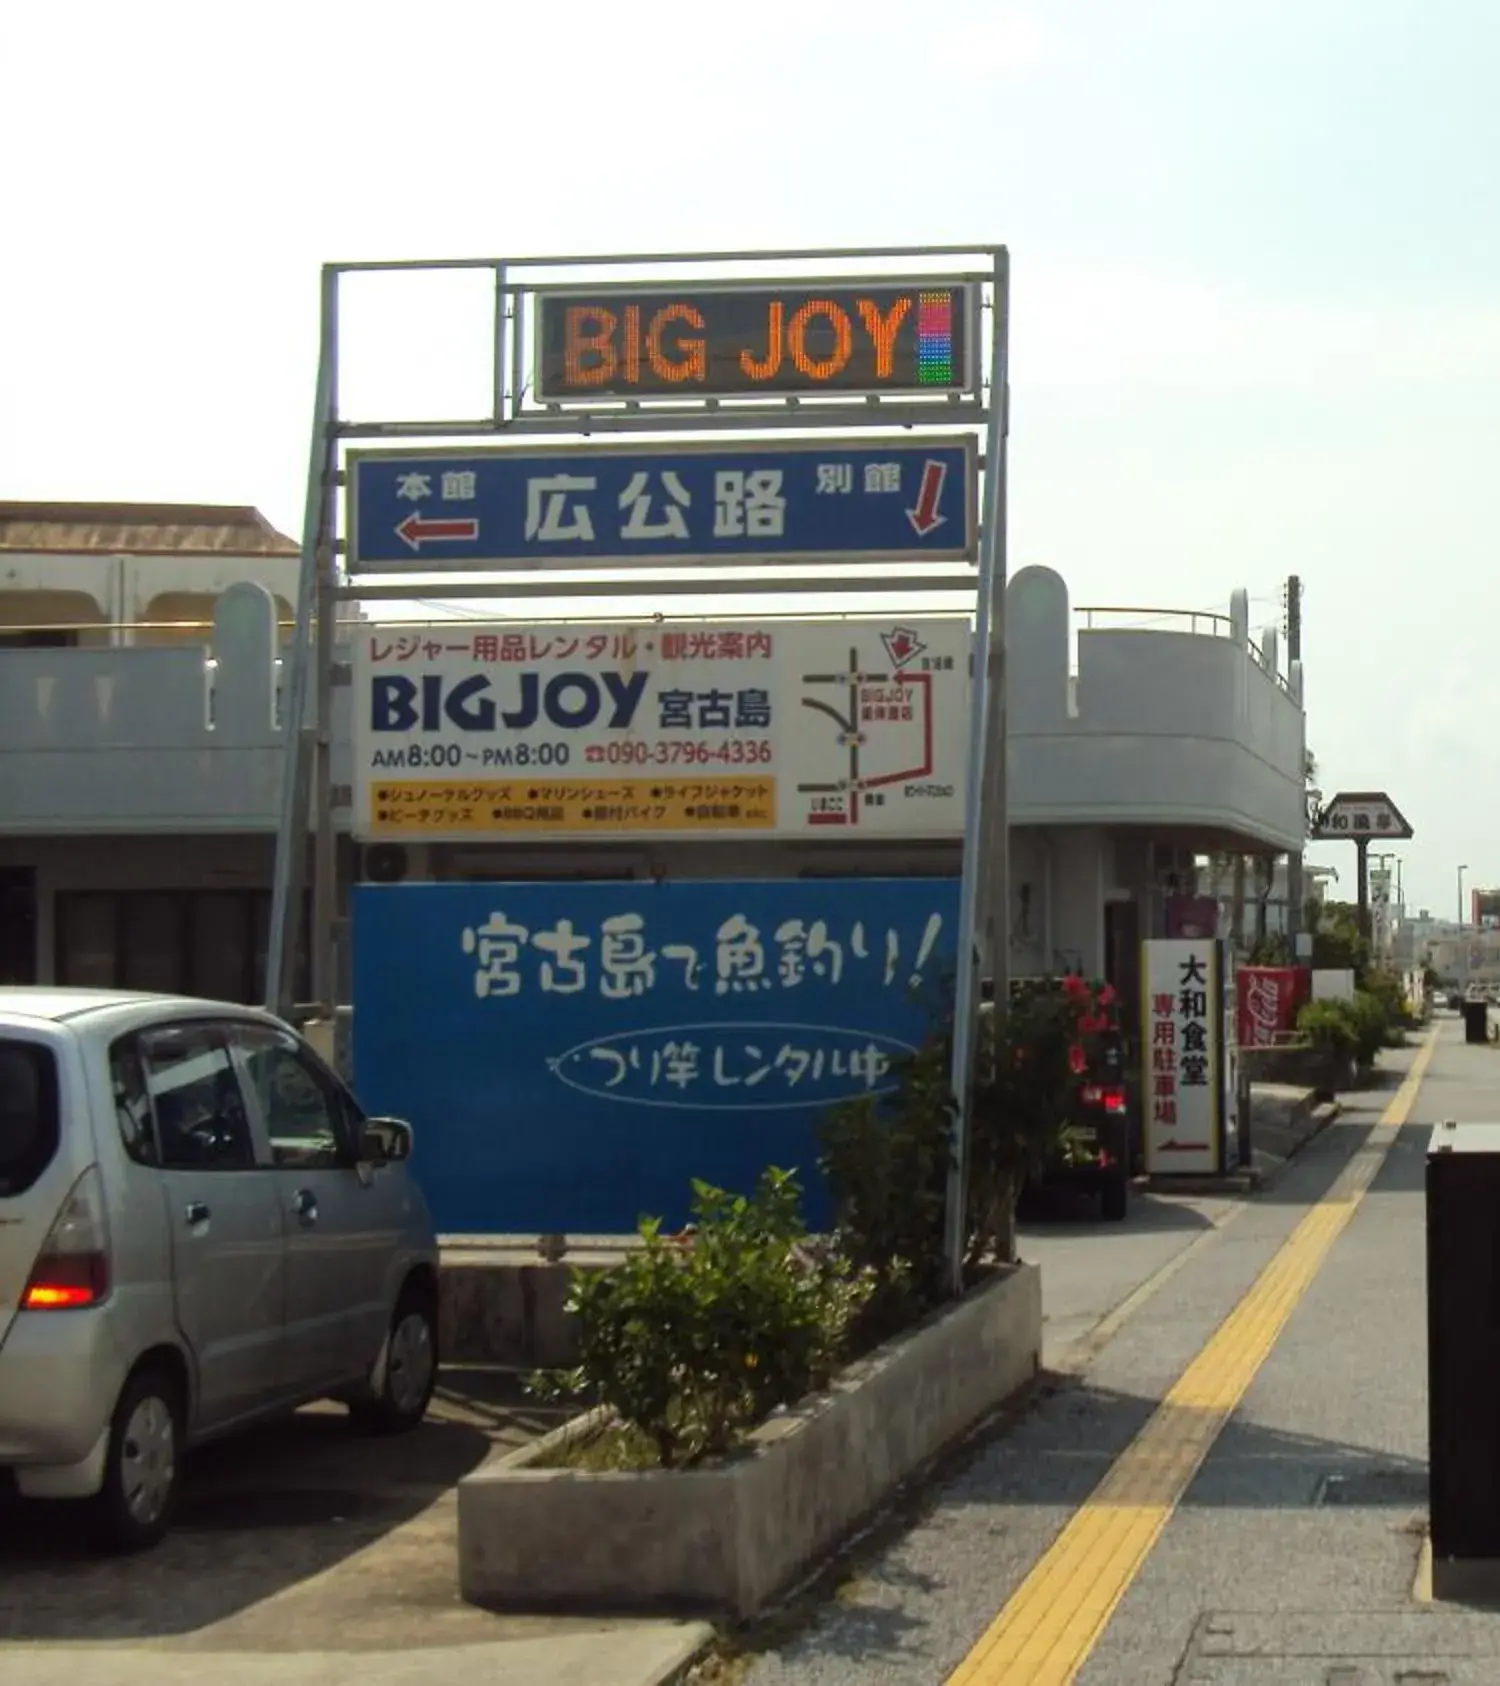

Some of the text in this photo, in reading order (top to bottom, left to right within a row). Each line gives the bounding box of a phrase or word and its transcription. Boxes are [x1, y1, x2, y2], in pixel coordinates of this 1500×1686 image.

[565, 297, 912, 386] BIG JOY
[396, 470, 477, 501] 本館
[815, 462, 901, 496] 別館
[524, 469, 788, 542] 広公路
[370, 631, 772, 663] レジャー用品レンタル・観光案内
[657, 688, 771, 730] 宮古島
[607, 740, 772, 765] 090-3796-4336
[462, 911, 943, 999] 宮古島で魚釣り!
[1178, 954, 1209, 1087] 大和食堂
[590, 1041, 893, 1089] つり竿レンタル中
[1152, 992, 1178, 1126] 専用駐車場
